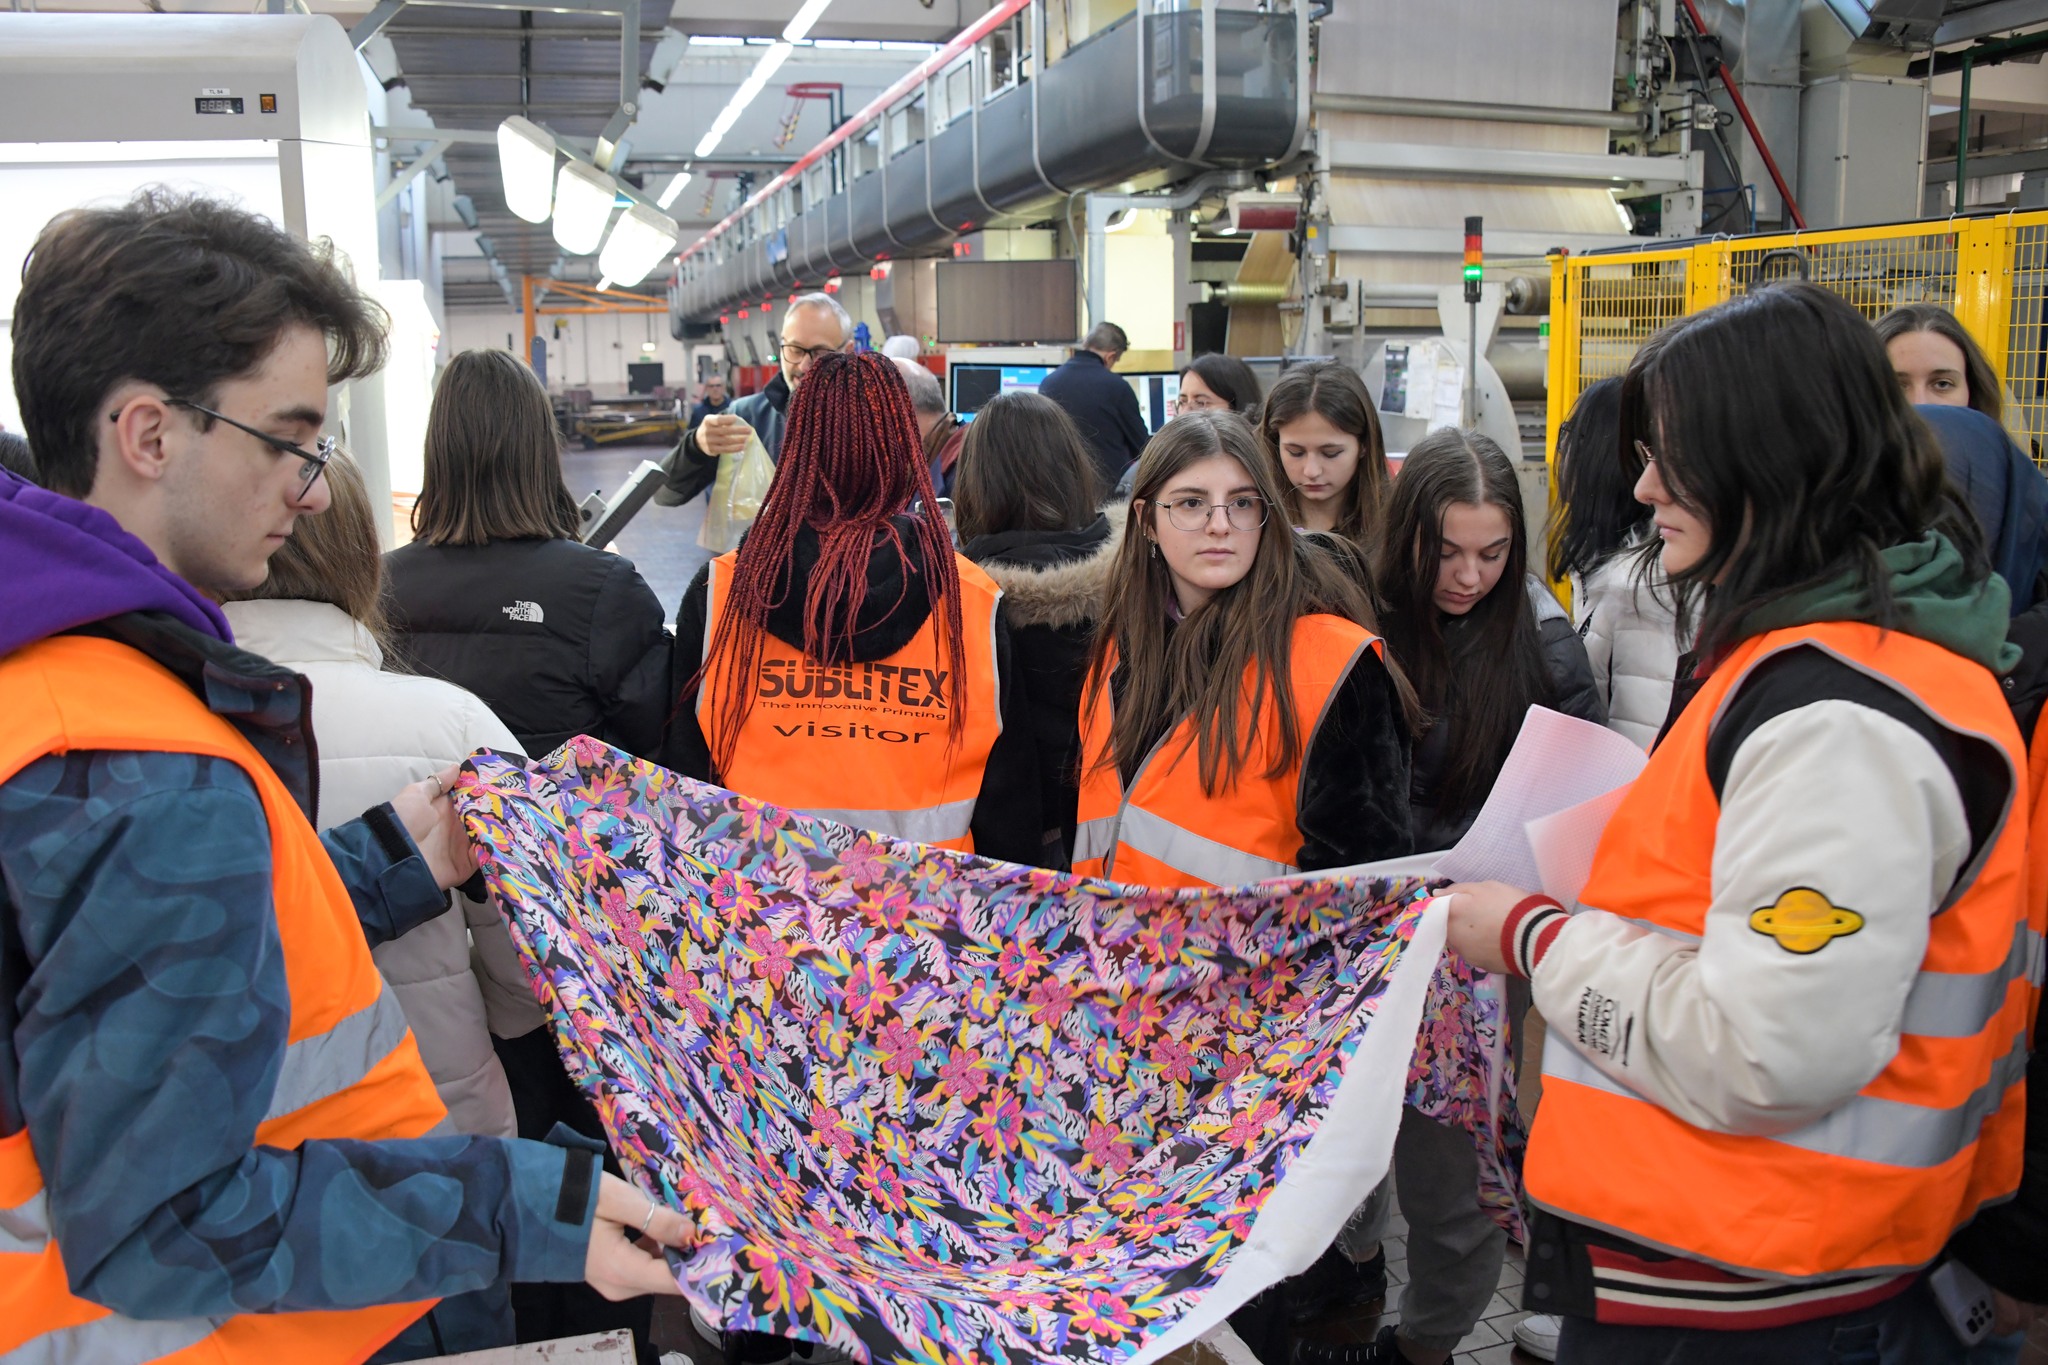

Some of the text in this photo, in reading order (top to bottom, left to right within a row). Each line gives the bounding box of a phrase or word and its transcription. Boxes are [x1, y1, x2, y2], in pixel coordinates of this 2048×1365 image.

[502, 606, 530, 615] NORTH
[515, 600, 531, 608] THE
[509, 613, 530, 622] FACE
[759, 659, 949, 709] SUBLITEX
[760, 701, 946, 721] The Innovative Printing
[773, 721, 930, 744] visitor
